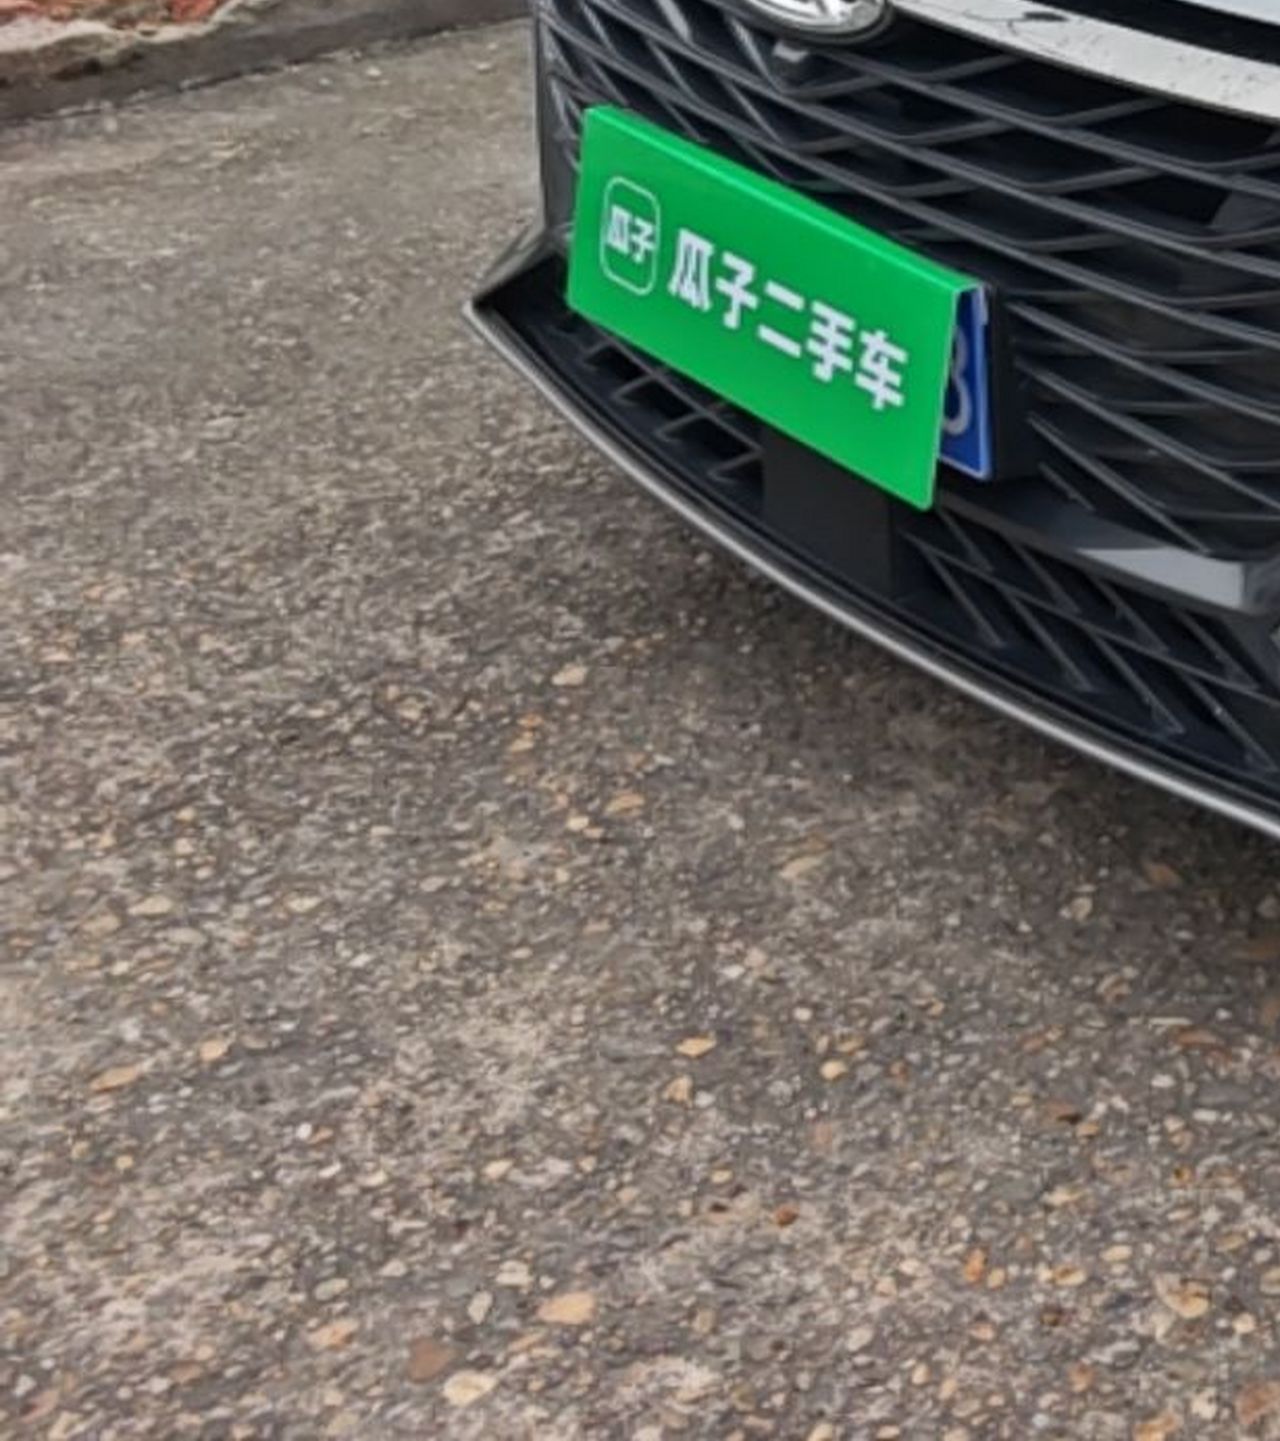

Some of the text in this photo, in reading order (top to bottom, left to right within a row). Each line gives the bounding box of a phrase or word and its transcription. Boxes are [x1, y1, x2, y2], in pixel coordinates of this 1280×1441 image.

[607, 205, 656, 262] 瓜子
[668, 227, 908, 411] 瓜子二手车
